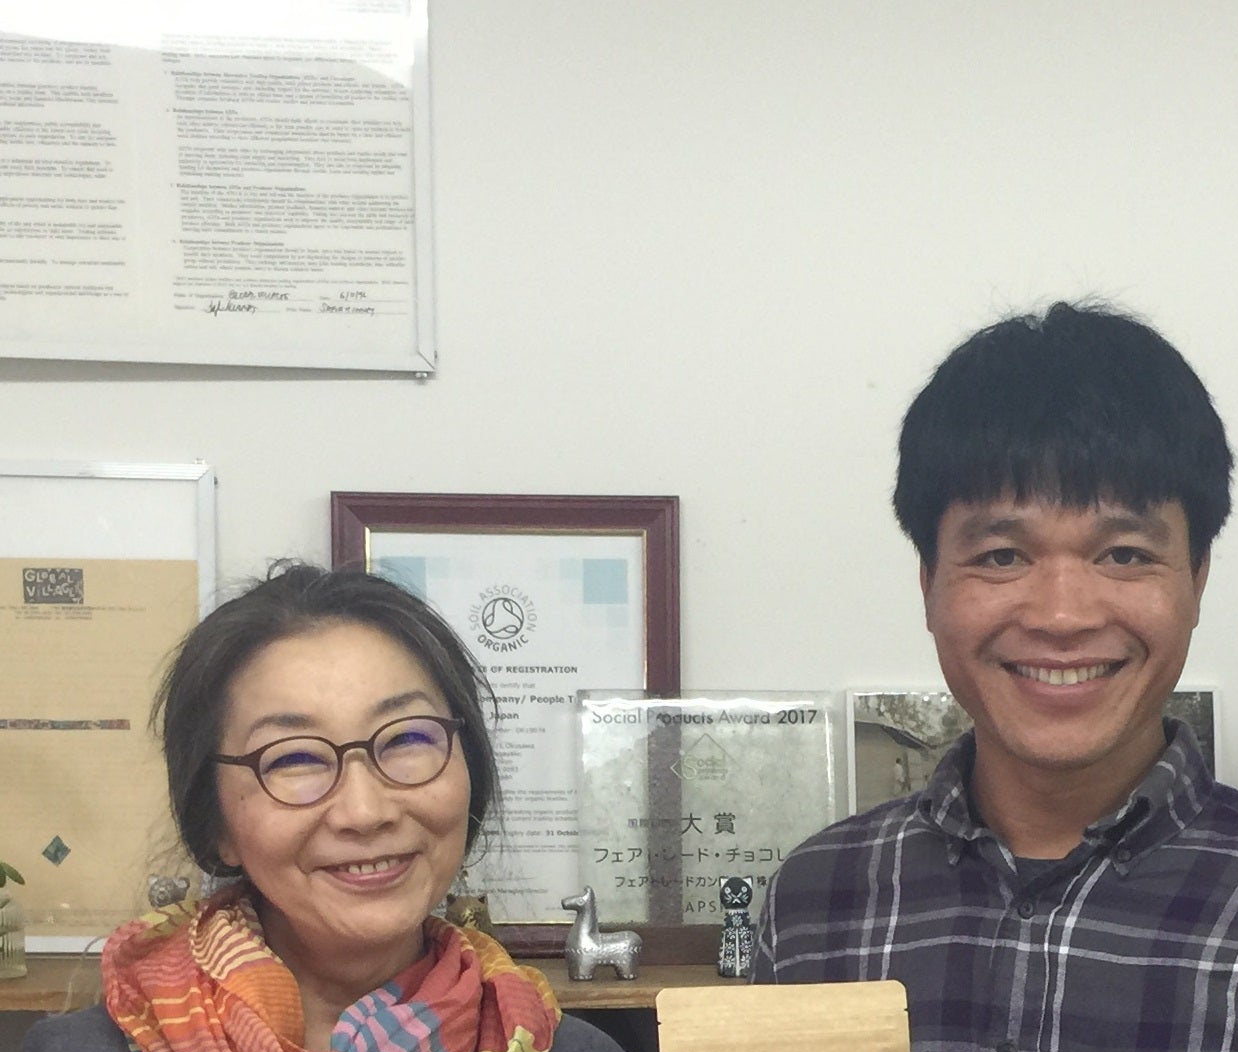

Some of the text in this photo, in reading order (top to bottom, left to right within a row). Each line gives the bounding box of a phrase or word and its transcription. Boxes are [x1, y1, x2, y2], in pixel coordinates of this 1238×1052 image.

[24, 569, 75, 584] GLOBAL
[469, 584, 538, 632] SOIL ASSOCIATION
[477, 633, 529, 653] ORGANIC
[506, 666, 578, 674] REGISTRATION
[530, 695, 565, 705] People
[592, 709, 817, 725] Social Products Award 2017
[680, 812, 736, 836] 大賞
[685, 900, 722, 913] APS
